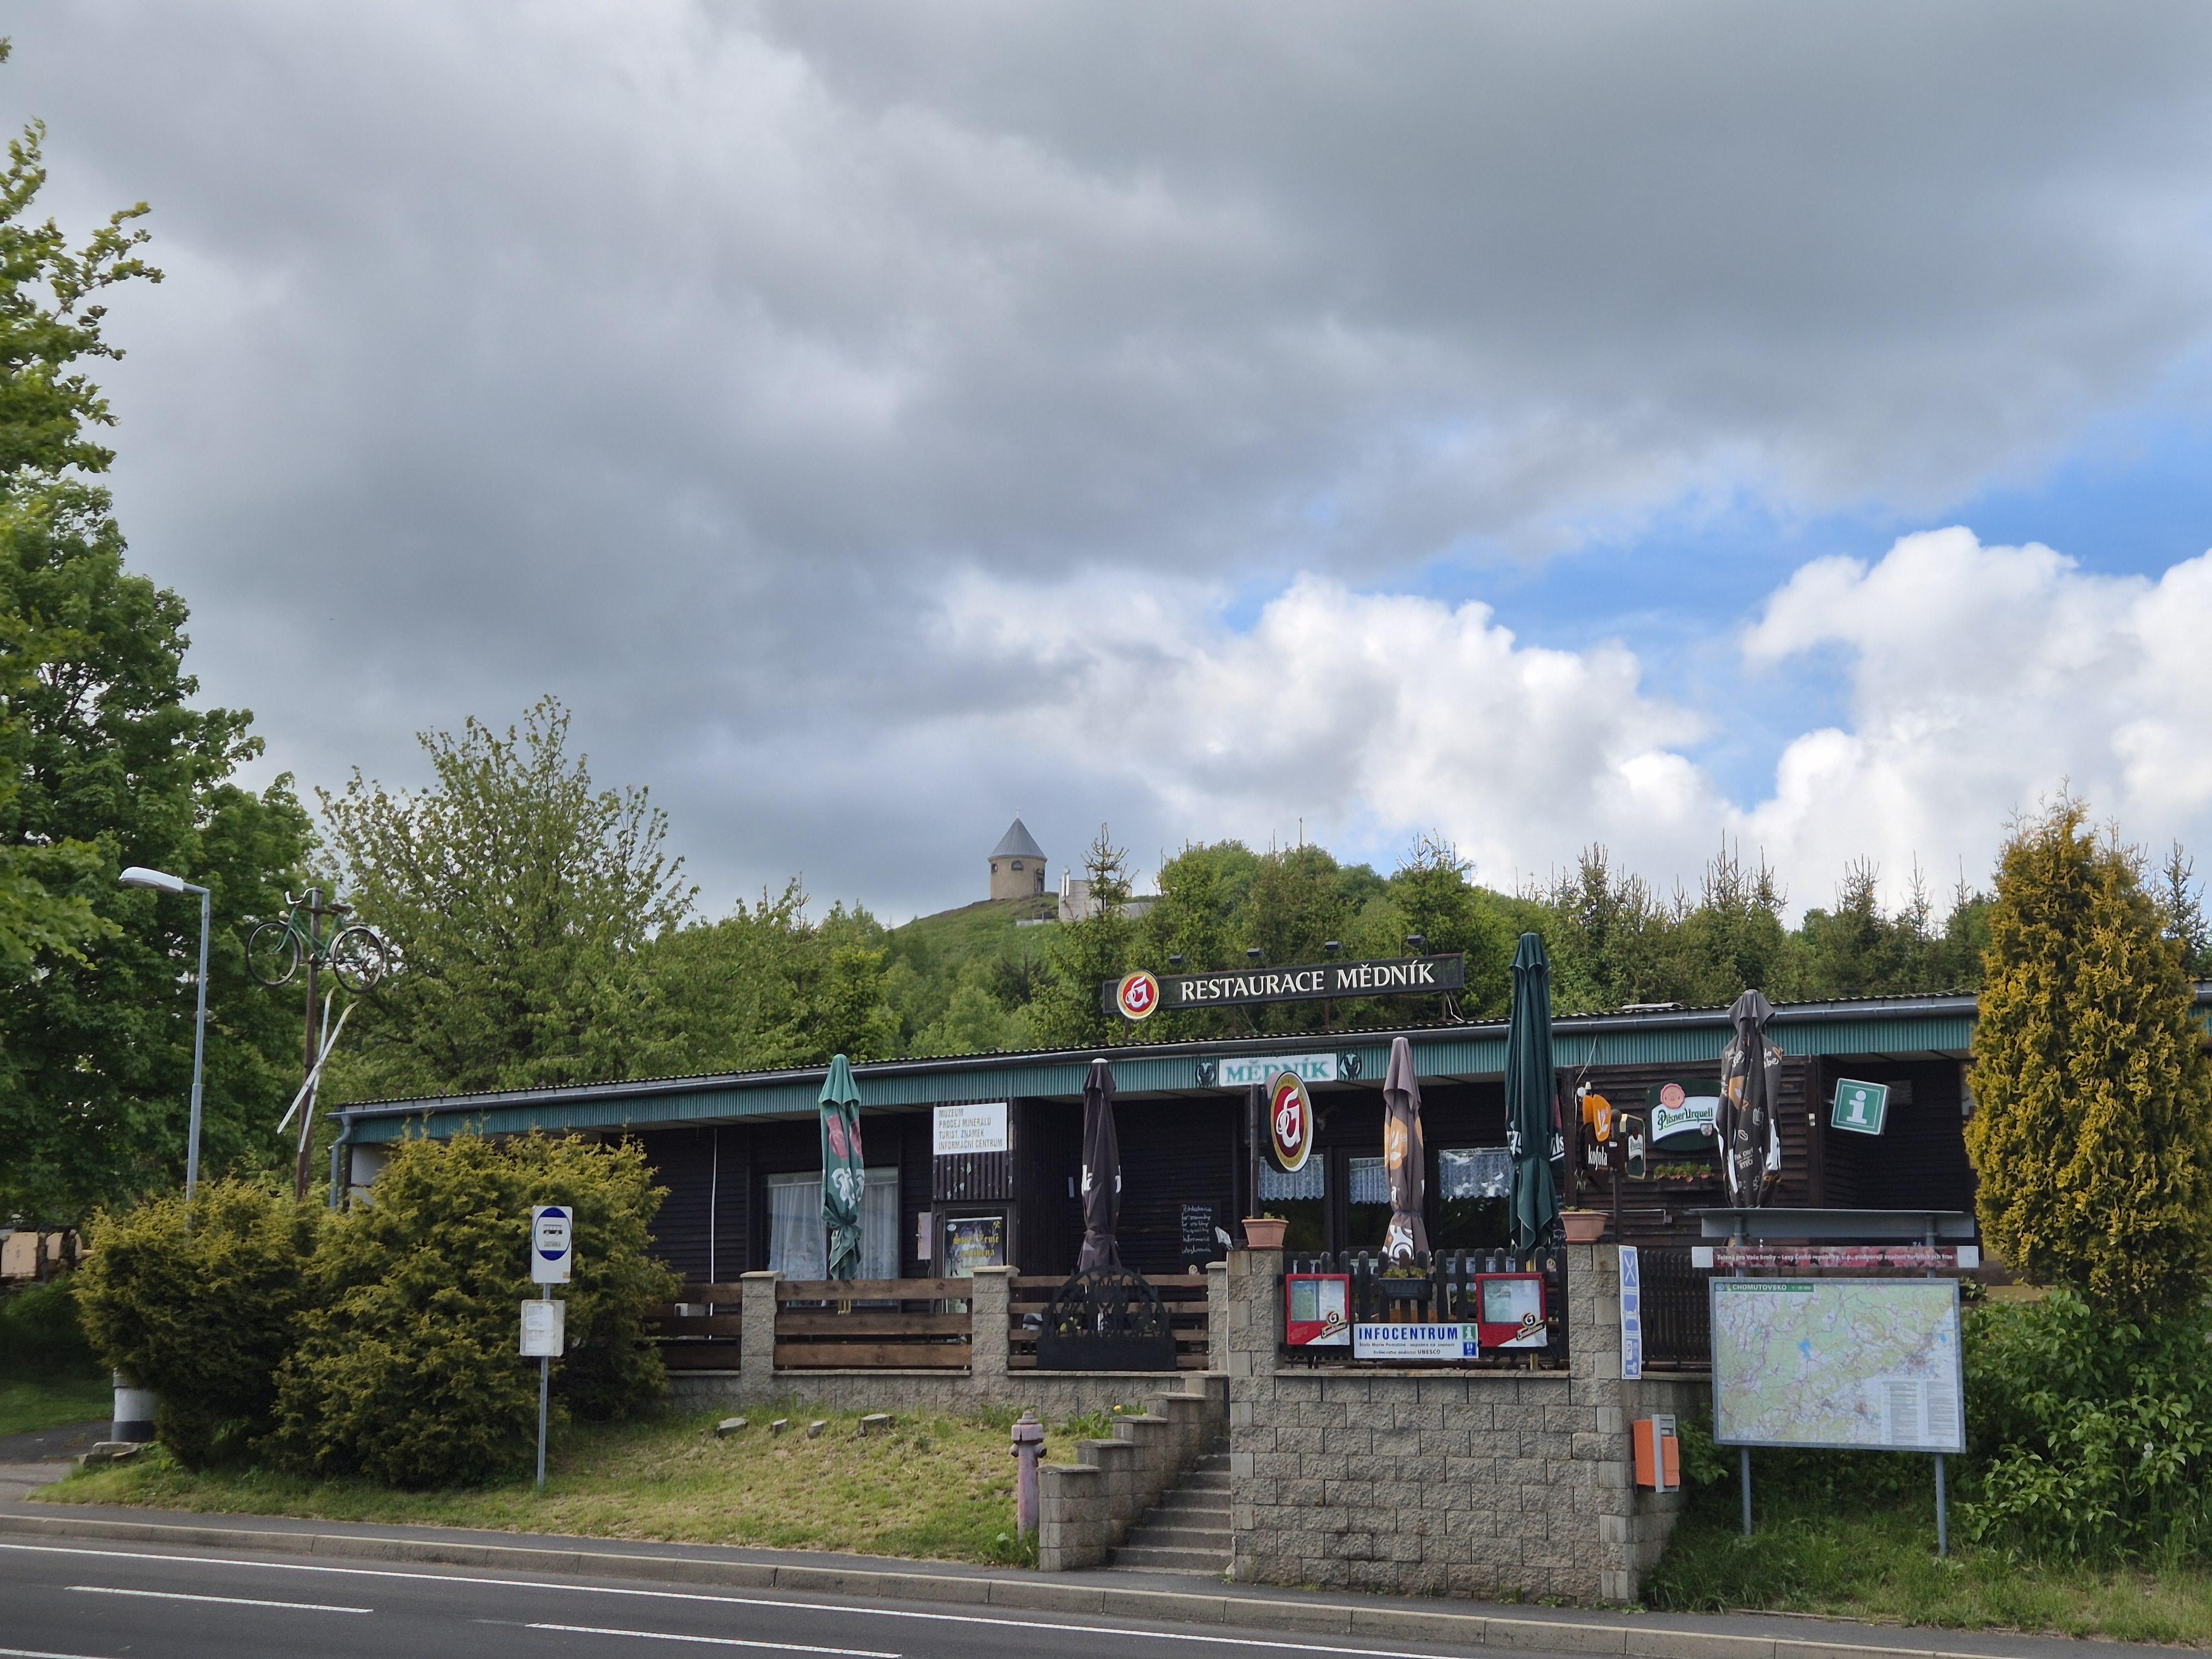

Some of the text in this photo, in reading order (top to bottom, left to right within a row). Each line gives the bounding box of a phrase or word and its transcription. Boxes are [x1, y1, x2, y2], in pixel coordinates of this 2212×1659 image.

[1181, 959, 1435, 1001] RESTAURACE MĚDNÍK
[939, 1108, 963, 1117] MUZEUM
[939, 1119, 961, 1128] PRODEJ
[1657, 1108, 1713, 1130] Pilsner Urquell
[939, 1130, 959, 1139] TURIST.
[939, 1138, 1003, 1150] INFORMAČNÍ CENTRUM
[1588, 1144, 1608, 1171] kofola
[1359, 1327, 1458, 1340] INFOCENTRUM
